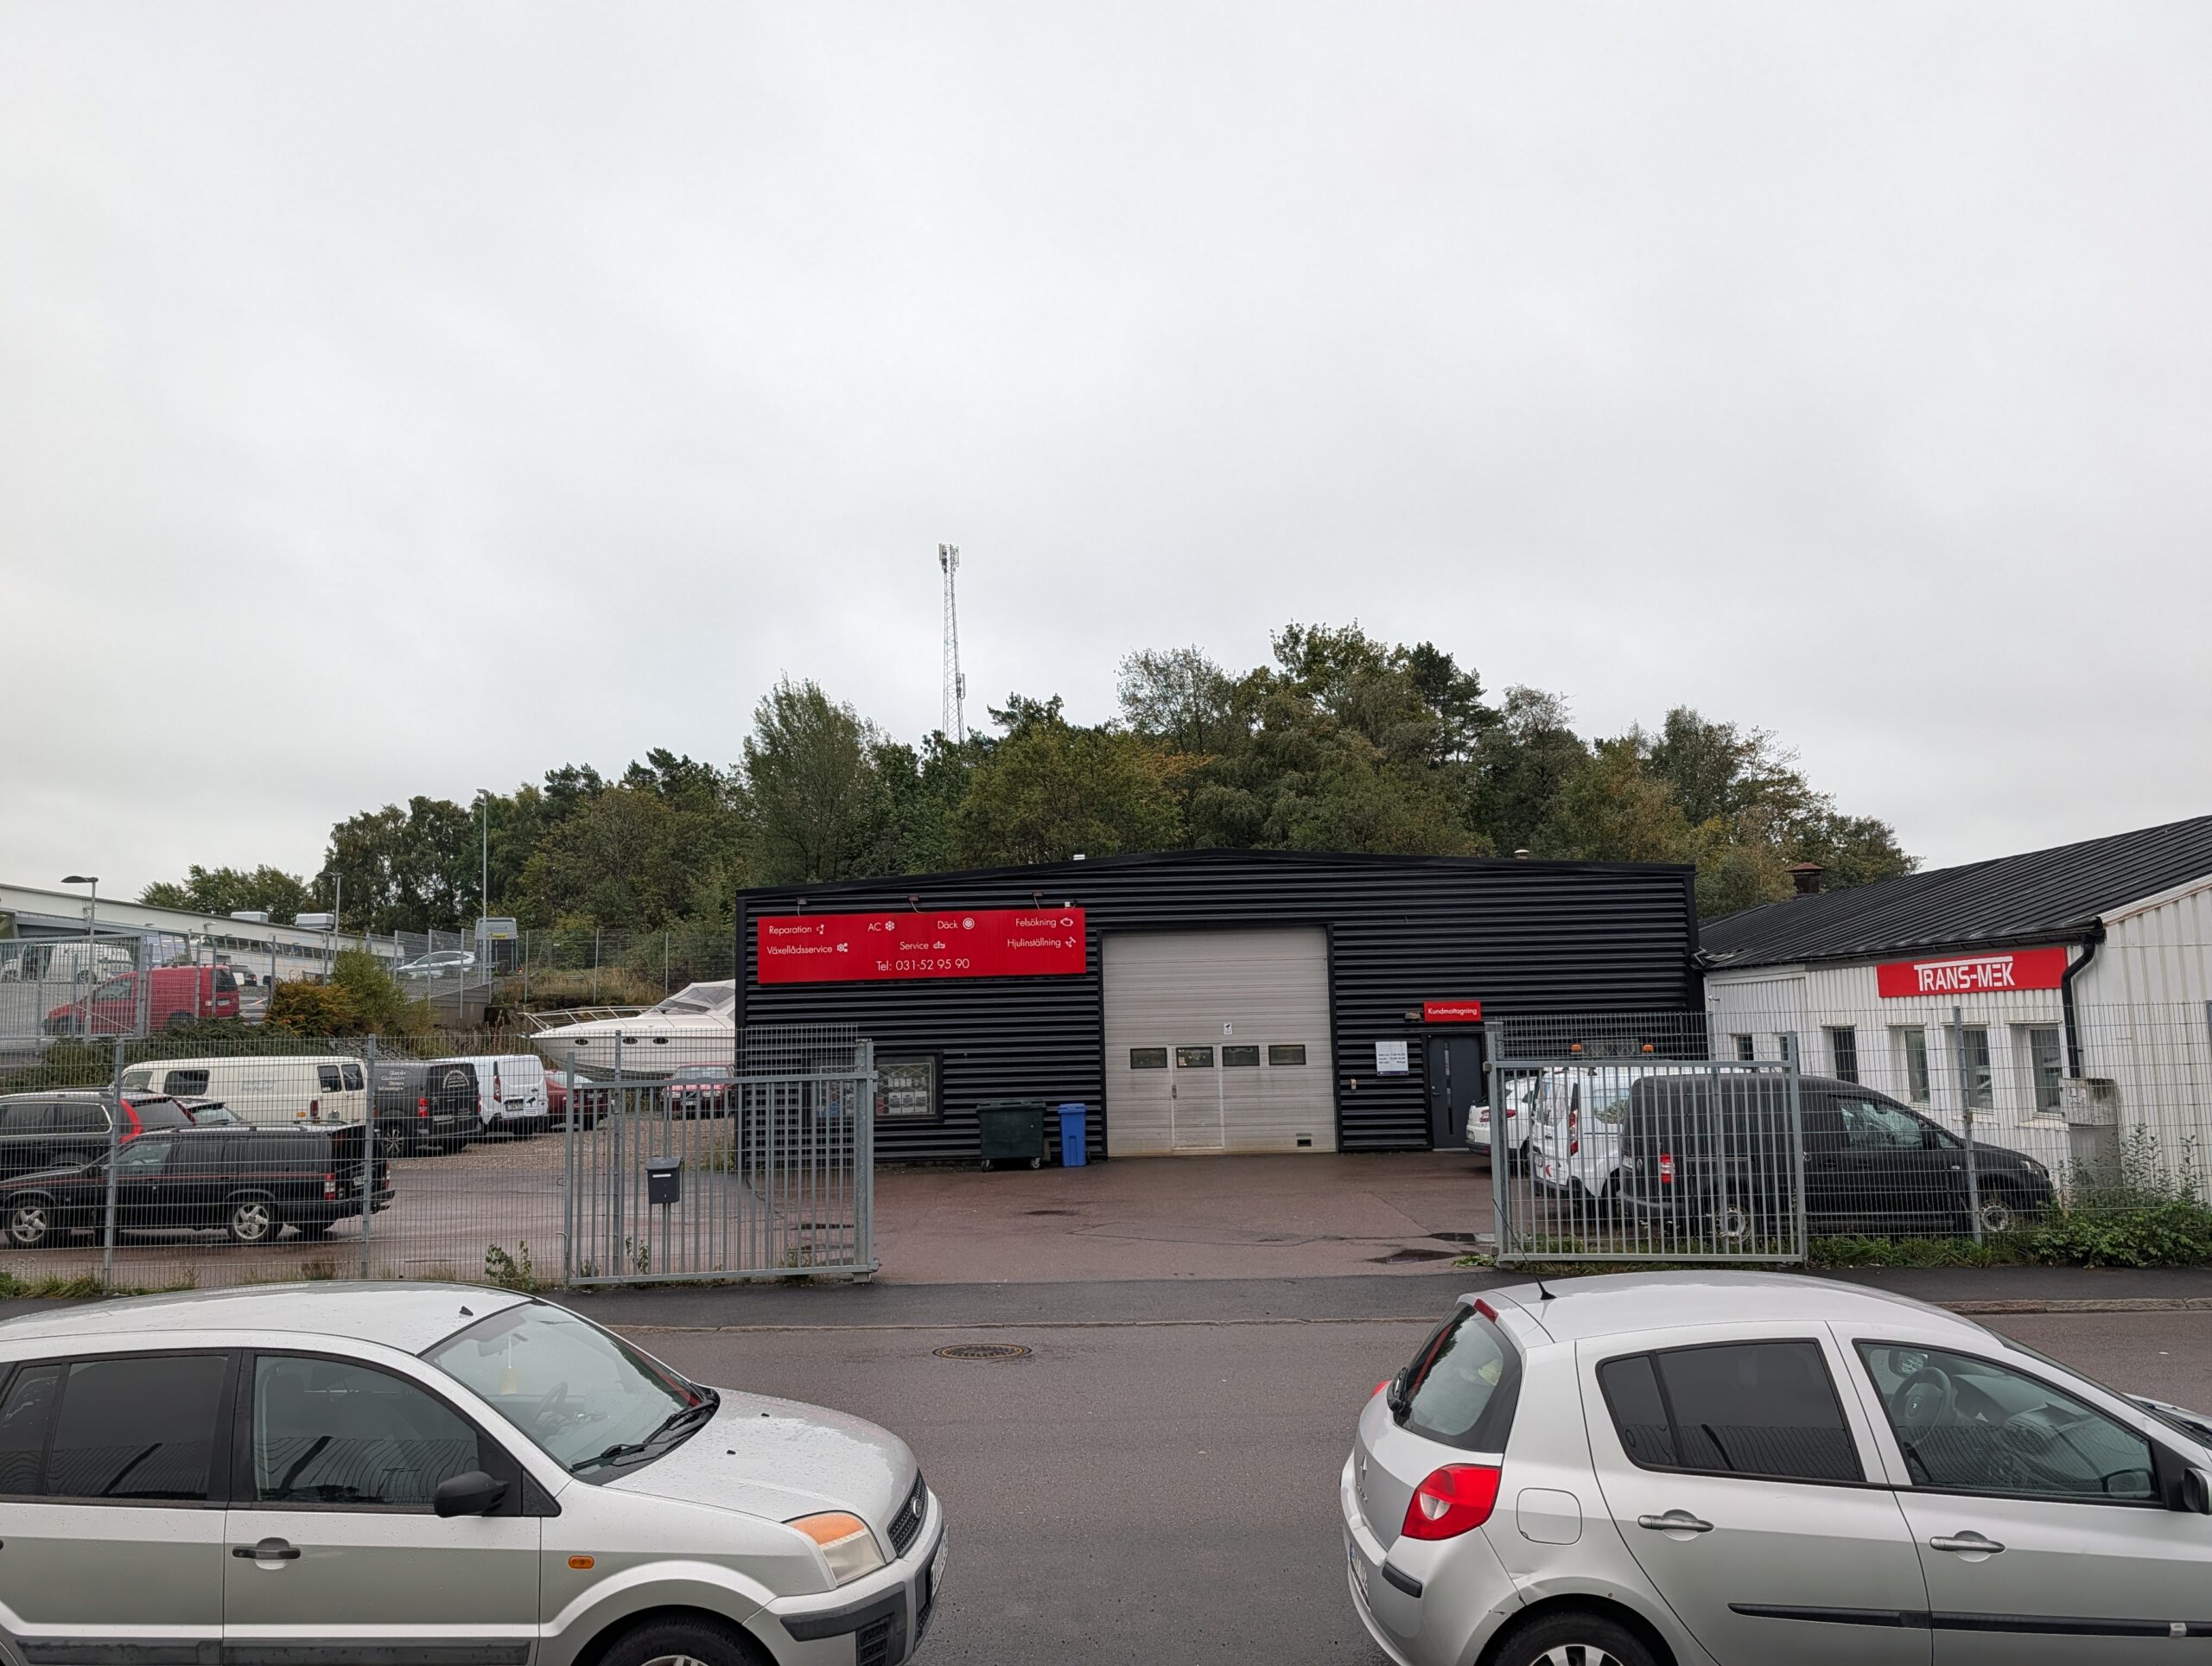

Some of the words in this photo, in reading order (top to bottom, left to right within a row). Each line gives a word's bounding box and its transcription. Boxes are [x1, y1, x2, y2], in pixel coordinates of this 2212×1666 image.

[868, 922, 881, 932] AC
[938, 919, 958, 929] Däck
[1015, 917, 1057, 928] Felsökning
[769, 925, 812, 936] Reparation
[899, 941, 929, 950] Service
[1007, 937, 1061, 950] Hjulinställning
[766, 944, 833, 955] Växellådsservice
[876, 960, 893, 971] Tel:
[895, 959, 934, 970] 031-52
[937, 958, 951, 970] 95
[955, 958, 970, 969] 90
[1913, 956, 2015, 992] TRANS-MEK
[1427, 1008, 1478, 1016] Kundmottagning
